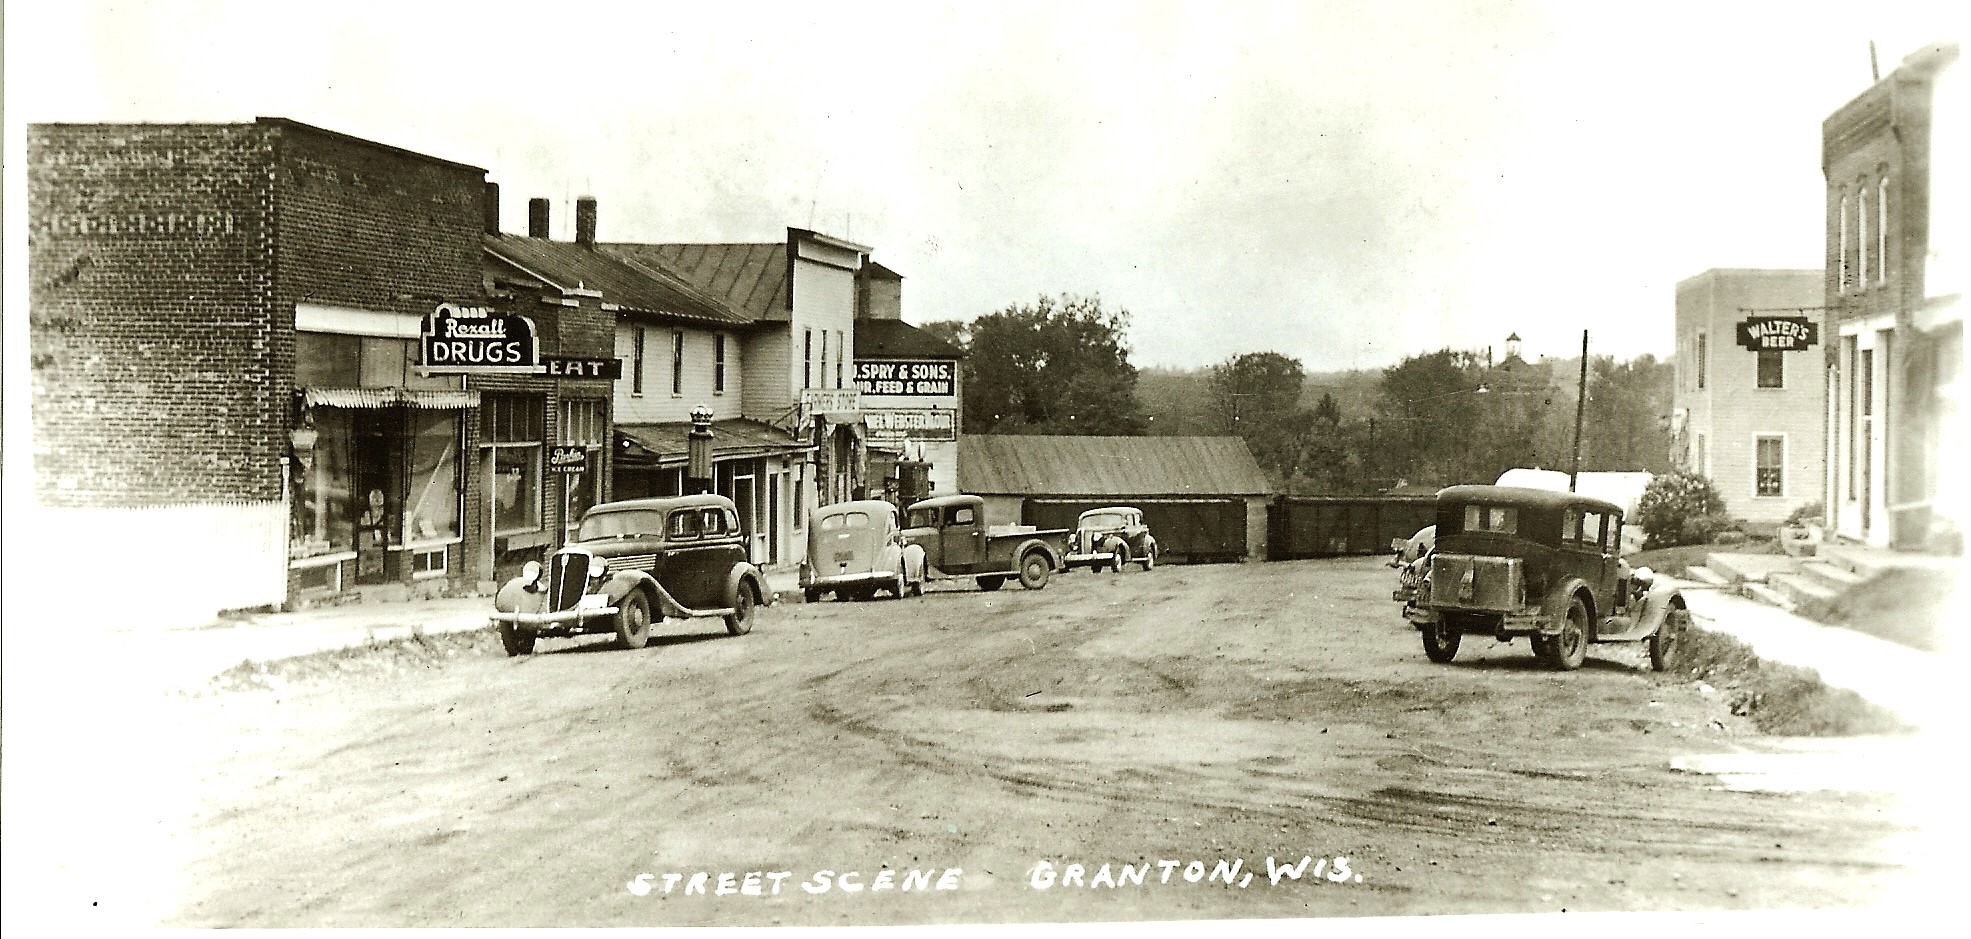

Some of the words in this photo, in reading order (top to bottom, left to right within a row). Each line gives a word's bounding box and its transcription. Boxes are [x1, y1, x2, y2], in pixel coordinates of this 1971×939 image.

[445, 318, 507, 338] Rexall
[1747, 320, 1809, 341] WALTER'S
[1762, 335, 1794, 348] BEER
[433, 340, 521, 363] DRUGS
[898, 364, 909, 380] &
[911, 364, 952, 380] SONS.
[916, 380, 949, 394] GRAIN
